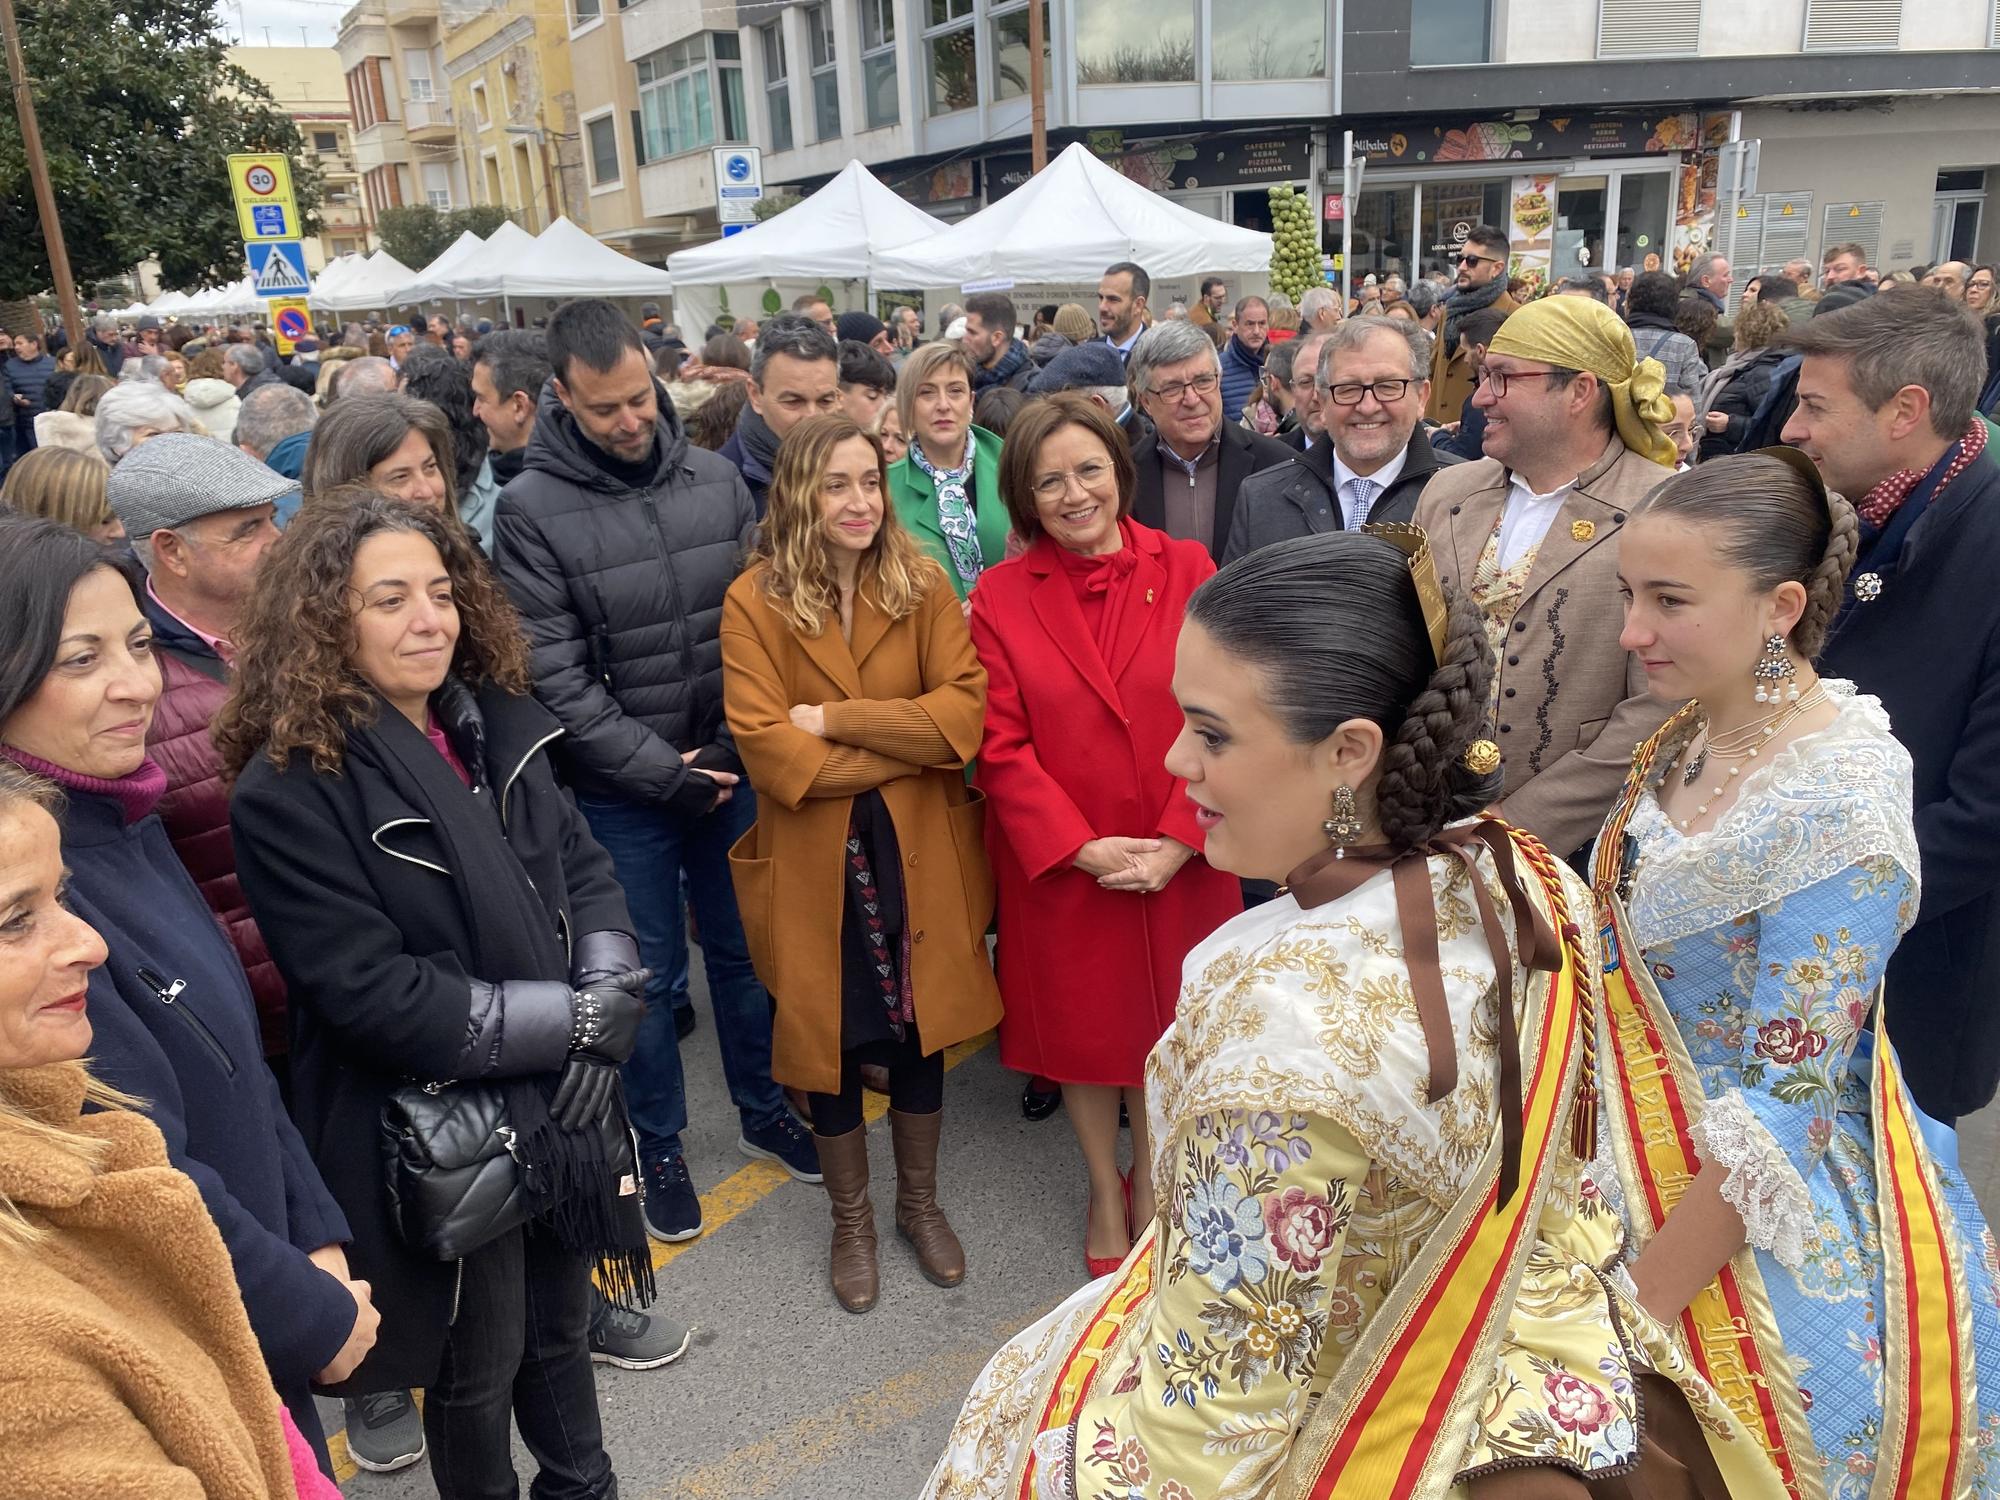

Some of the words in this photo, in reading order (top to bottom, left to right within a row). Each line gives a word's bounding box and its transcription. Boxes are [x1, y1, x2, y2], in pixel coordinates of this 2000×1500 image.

[1244, 141, 1286, 150] CAFETERIA
[1353, 139, 1388, 151] Alibaba
[1248, 158, 1283, 166] PIZZERIA
[1238, 164, 1292, 174] RESTAURANTE
[252, 175, 270, 185] 30
[1614, 1003, 1677, 1149] Fallera
[1697, 1316, 1800, 1492] Infan
